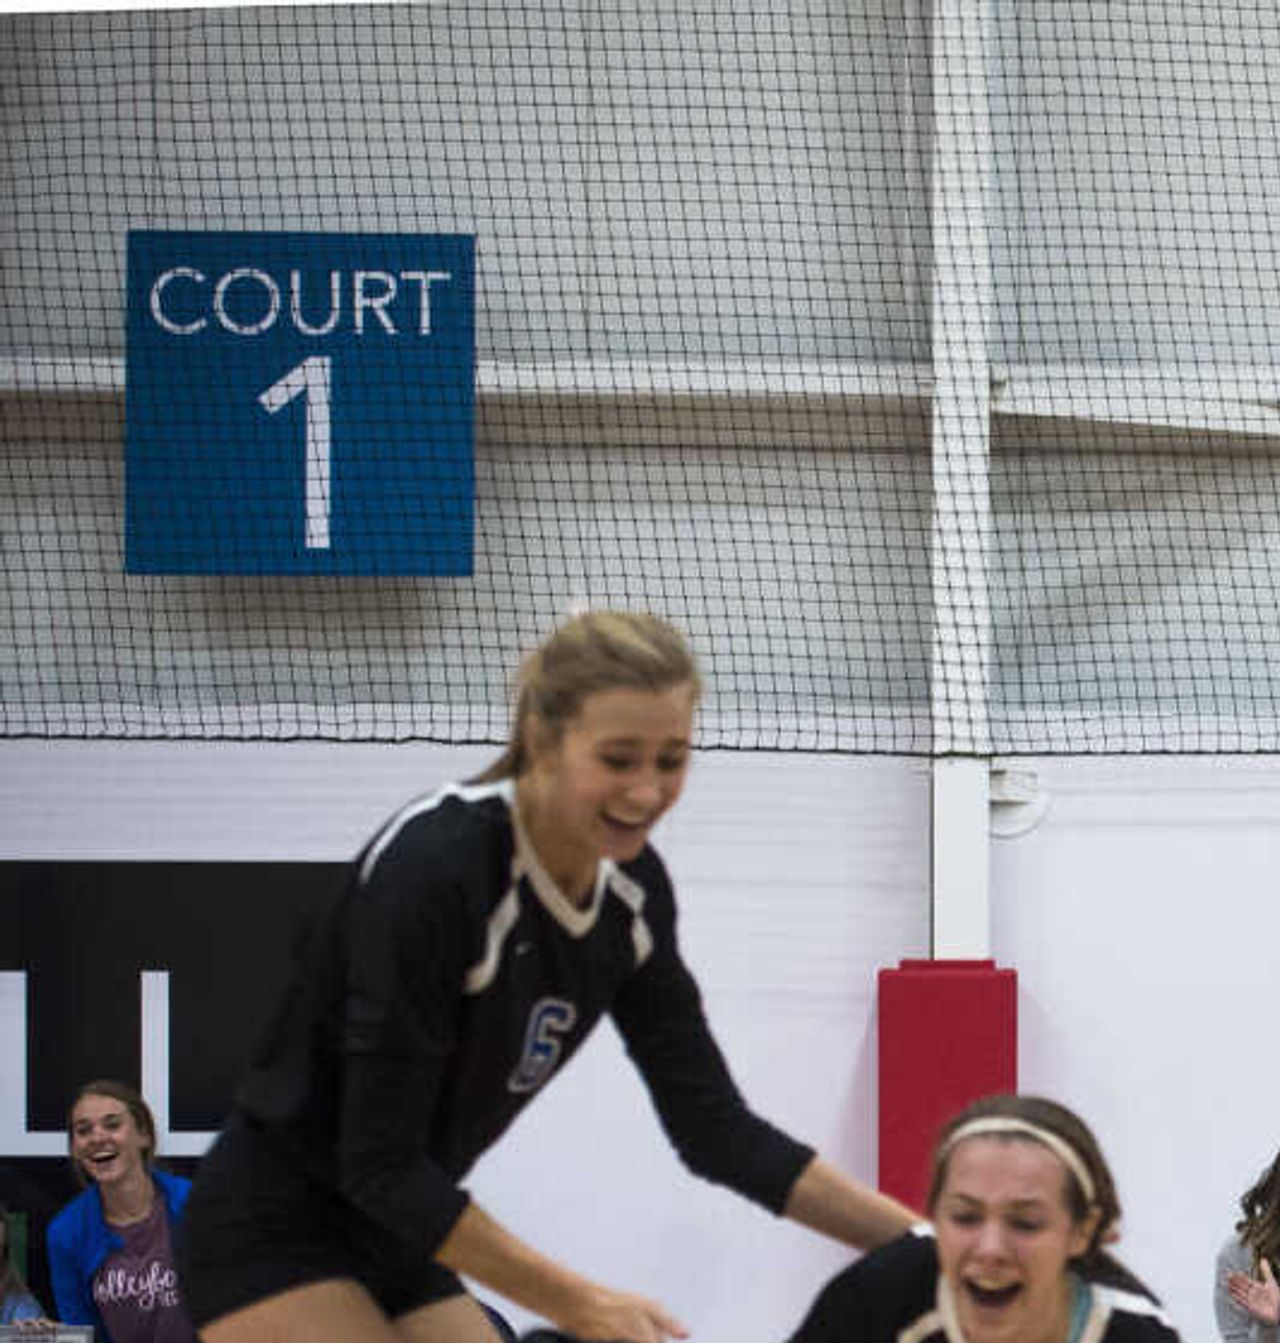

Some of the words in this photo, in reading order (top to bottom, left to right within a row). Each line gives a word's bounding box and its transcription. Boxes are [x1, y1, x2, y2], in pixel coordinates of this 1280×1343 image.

[150, 266, 452, 336] COURT
[257, 355, 331, 549] 1
[507, 998, 577, 1093] 6
